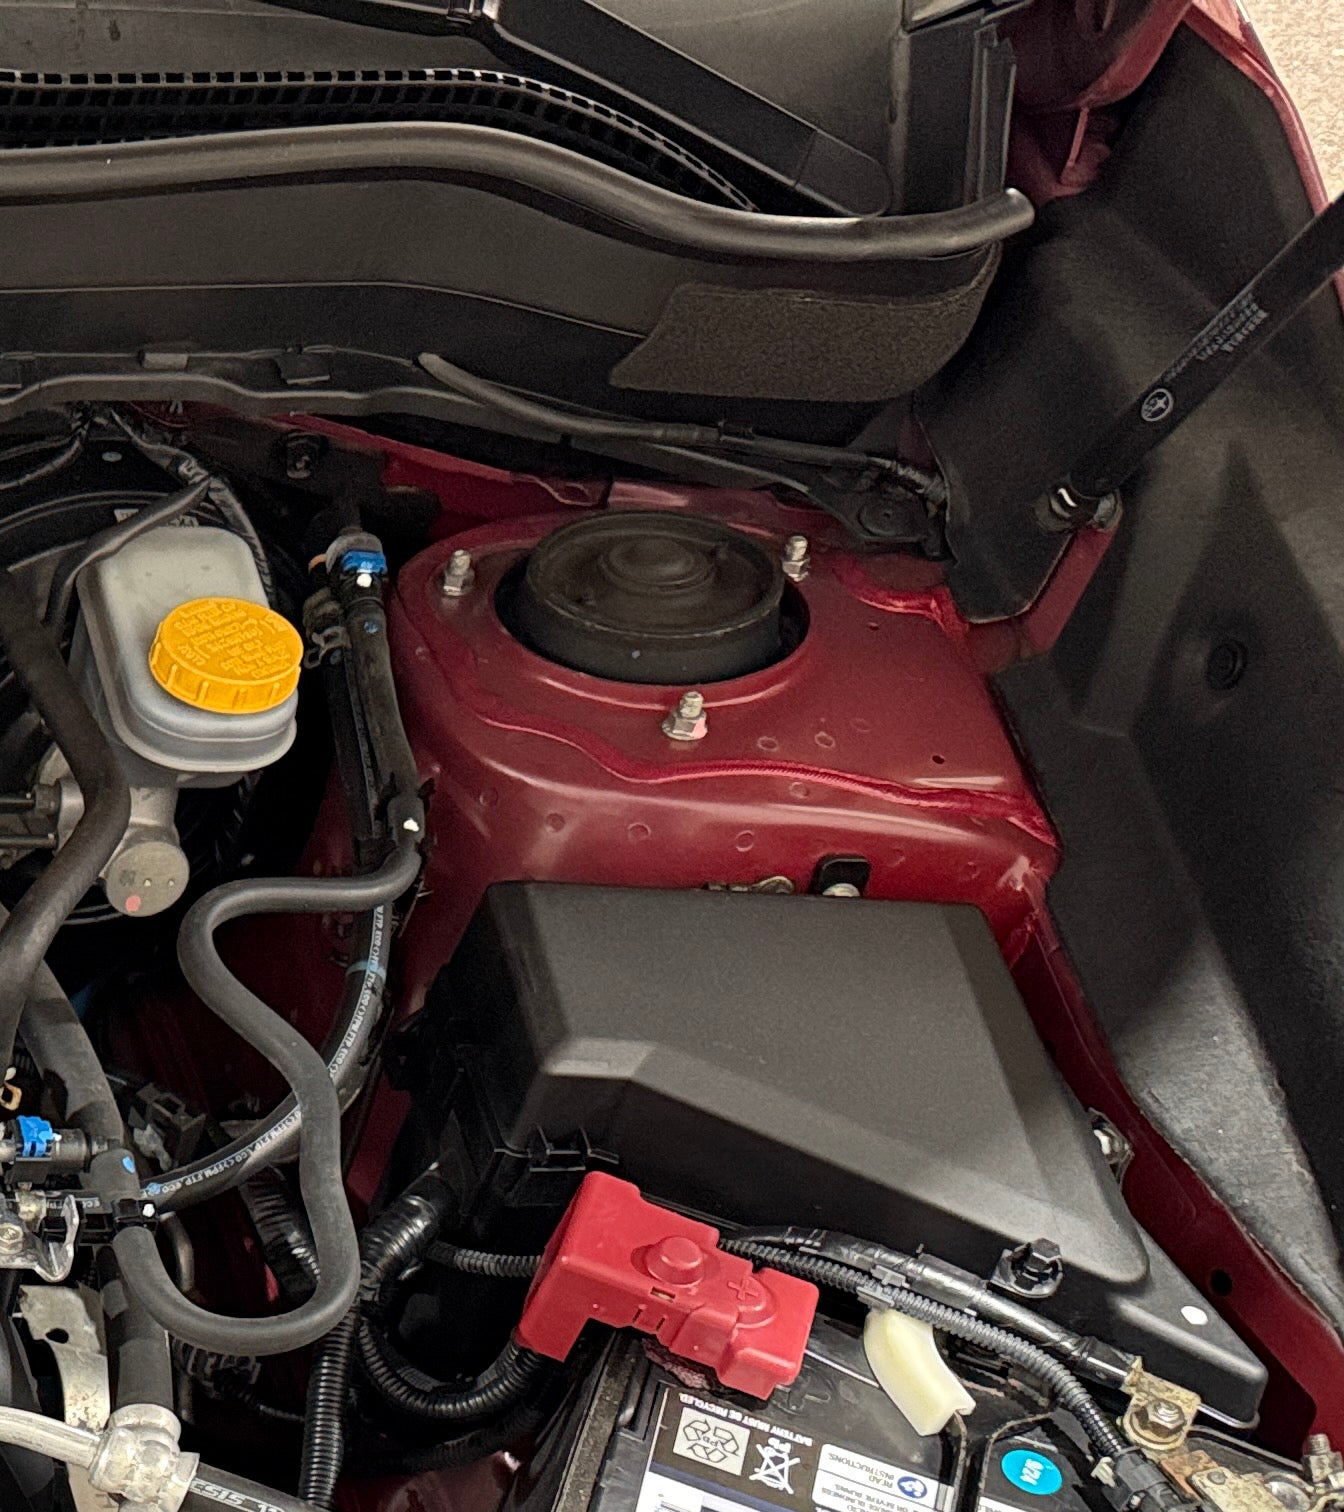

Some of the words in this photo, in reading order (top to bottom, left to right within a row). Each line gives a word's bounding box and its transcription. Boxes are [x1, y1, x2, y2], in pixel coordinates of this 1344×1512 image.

[727, 1409, 742, 1421] BE
[741, 1414, 770, 1432] MUST
[770, 1425, 813, 1446] BATTERY
